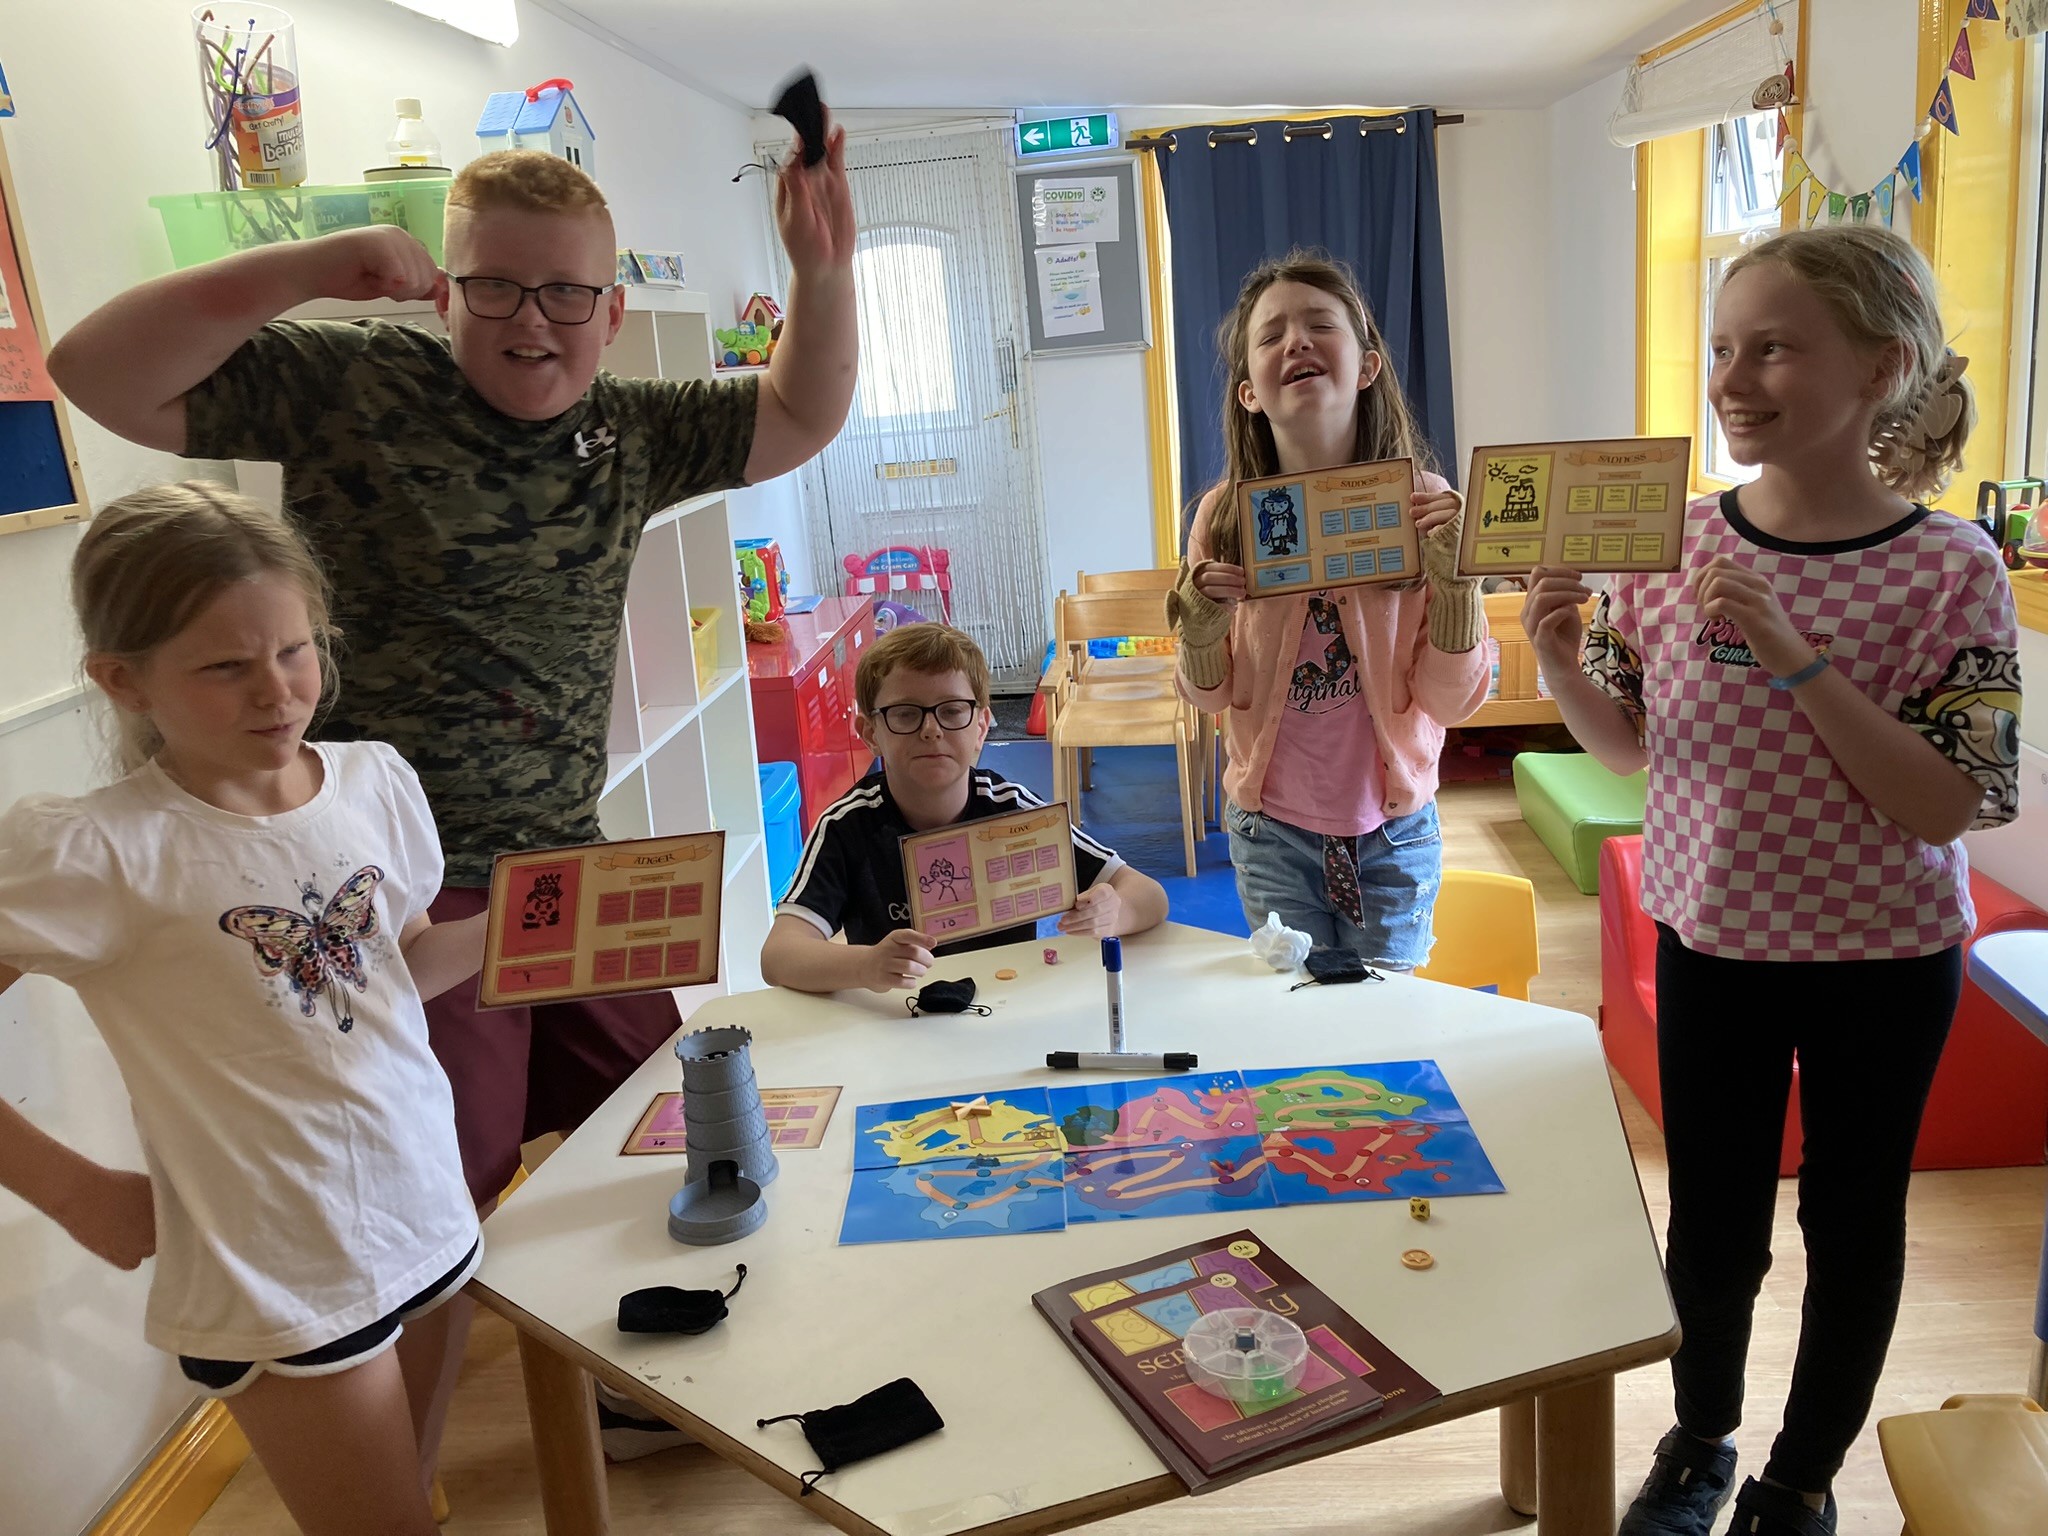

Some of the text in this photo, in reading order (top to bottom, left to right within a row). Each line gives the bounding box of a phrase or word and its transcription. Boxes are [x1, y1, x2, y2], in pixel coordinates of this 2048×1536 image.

[1045, 191, 1083, 200] COVID19
[1597, 453, 1648, 465] SADNESS
[1339, 475, 1380, 489] SADNESS
[1009, 825, 1031, 835] LOVE
[633, 853, 676, 866] ANGER
[1233, 1244, 1250, 1253] 9+
